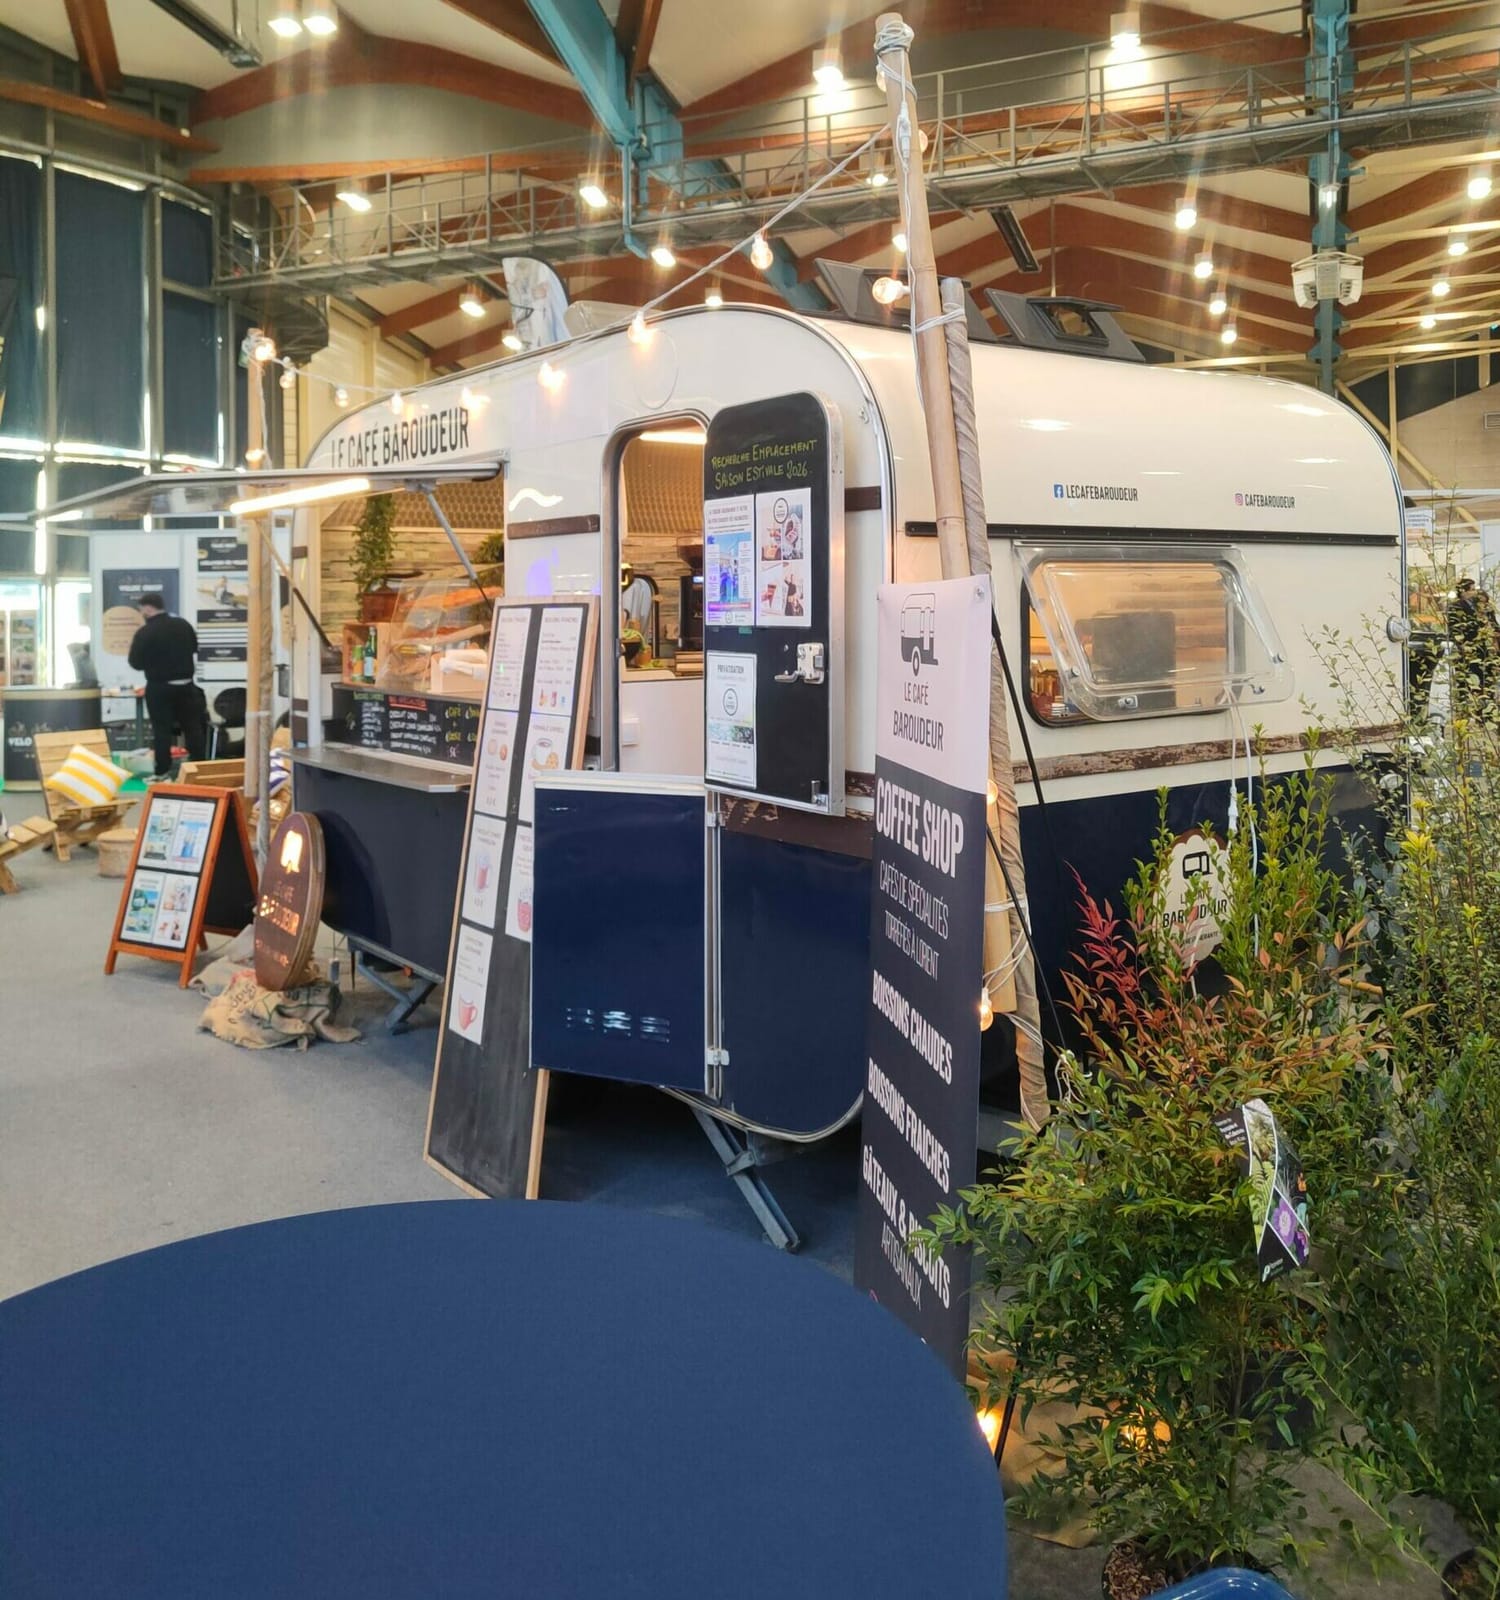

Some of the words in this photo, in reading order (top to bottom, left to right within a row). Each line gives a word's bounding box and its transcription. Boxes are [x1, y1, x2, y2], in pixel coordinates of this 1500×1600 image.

[347, 421, 379, 468] CAFÉ
[383, 406, 469, 465] BAROUDEUR
[711, 452, 750, 470] RECHERCHE
[752, 439, 818, 461] EMPLACEMENT
[786, 460, 808, 479] 2026
[1065, 485, 1138, 502] LECAFEBAROUDEUR
[1244, 493, 1296, 509] CAFEBAROUDEUR
[904, 682, 912, 703] LE
[912, 681, 929, 706] CAFÉ
[893, 710, 944, 752] BAROUDEUR
[875, 777, 921, 857] COFFEE
[921, 799, 964, 879] SHOP
[879, 859, 899, 902] CAFÉS
[898, 872, 907, 908] DE
[907, 879, 949, 940] SPÉCIALITÉS
[872, 968, 910, 1040] BOISSONS
[910, 1007, 953, 1086] CHAUDES
[868, 1056, 906, 1135] BOISSONS
[905, 1103, 950, 1195] FRAICHES
[862, 1144, 899, 1227] GÂTEAUX
[898, 1198, 907, 1242] &
[881, 1220, 922, 1312] ARTISANAUX
